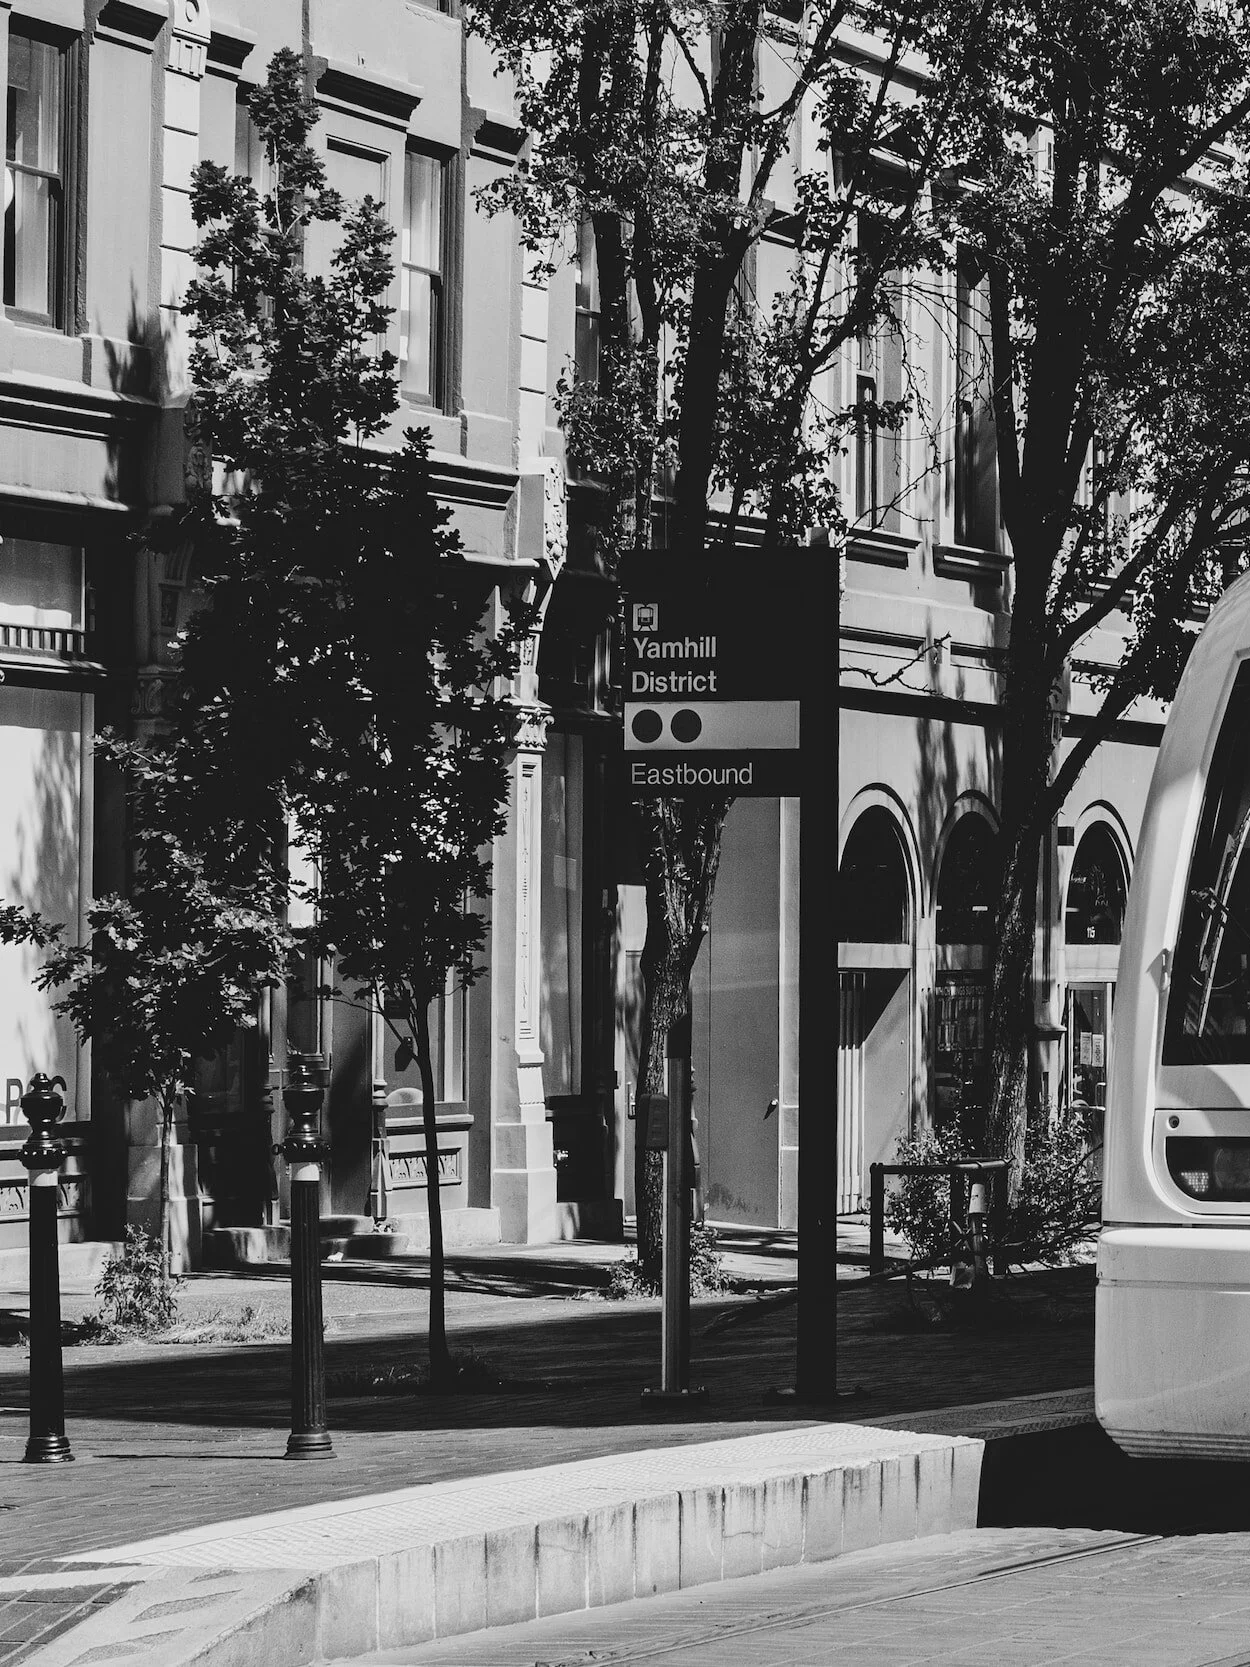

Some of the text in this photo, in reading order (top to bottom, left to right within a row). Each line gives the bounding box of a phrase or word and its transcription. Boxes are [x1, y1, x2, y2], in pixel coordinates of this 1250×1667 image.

[632, 636, 717, 659] Yamhill
[631, 670, 717, 693] District
[631, 762, 753, 785] Eastbound
